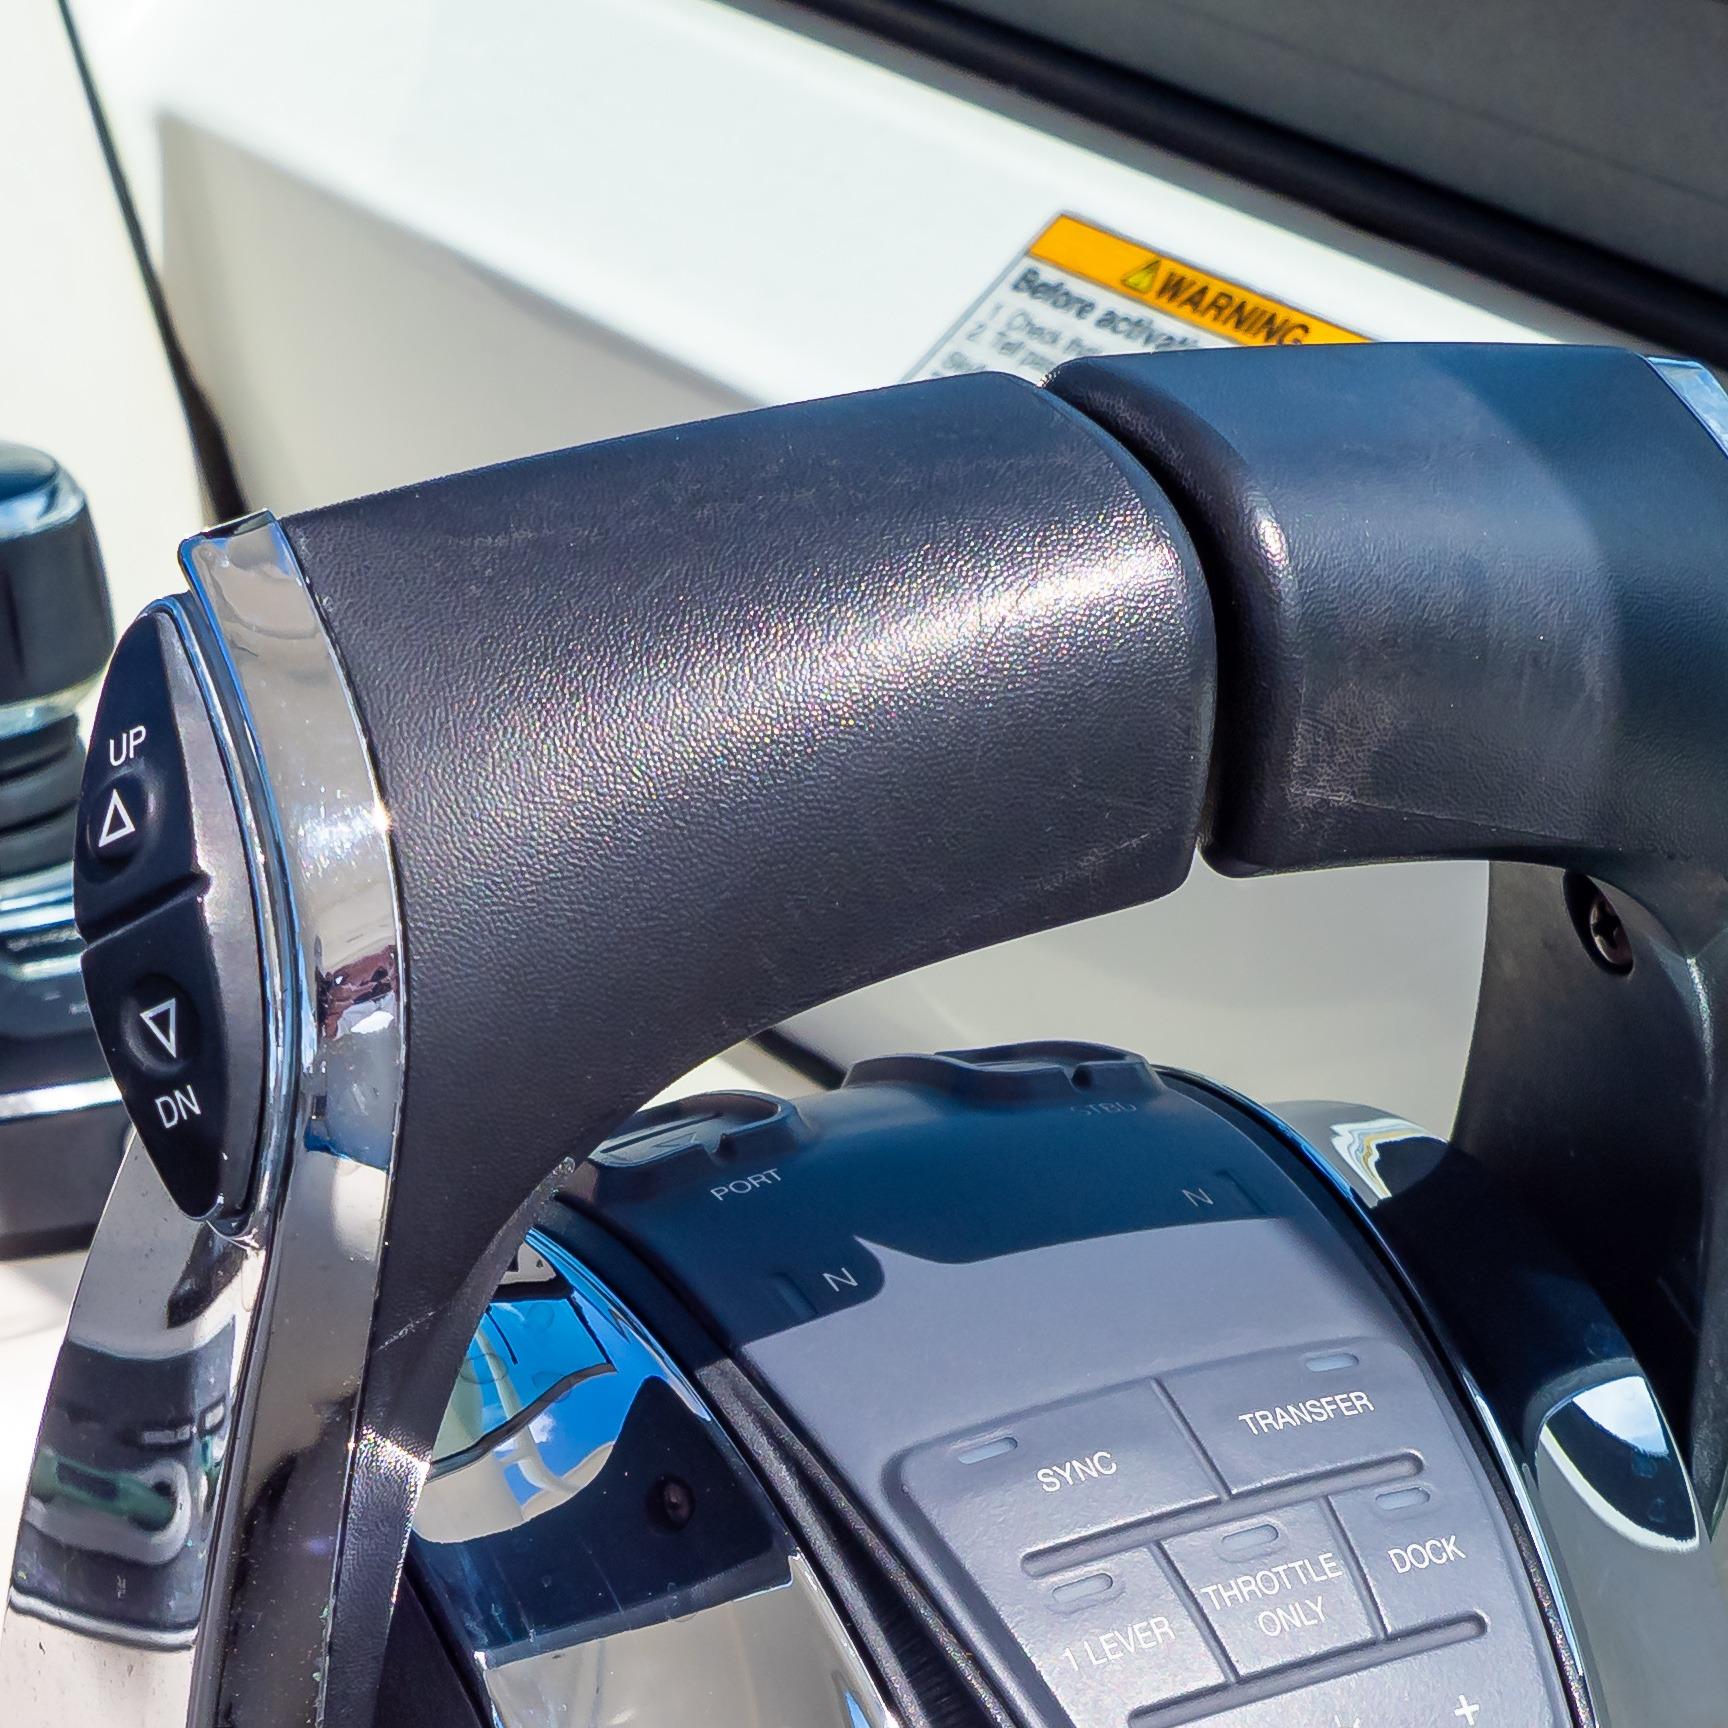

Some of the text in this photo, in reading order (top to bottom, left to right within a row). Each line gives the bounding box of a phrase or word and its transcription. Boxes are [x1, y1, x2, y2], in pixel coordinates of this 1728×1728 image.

[1157, 271, 1310, 345] WARNING
[109, 725, 147, 767] UP
[154, 1083, 202, 1130] DN
[710, 1168, 782, 1201] PORT
[1181, 1187, 1215, 1208] N
[822, 1267, 858, 1292] N
[1238, 1390, 1375, 1439] TRANSFER
[1035, 1450, 1118, 1494] SYNC
[1386, 1534, 1467, 1575] DOCK
[1200, 1551, 1343, 1611] THROTTLE
[1257, 1595, 1328, 1638] ONLY
[1062, 1615, 1177, 1673] 1 LEVER
